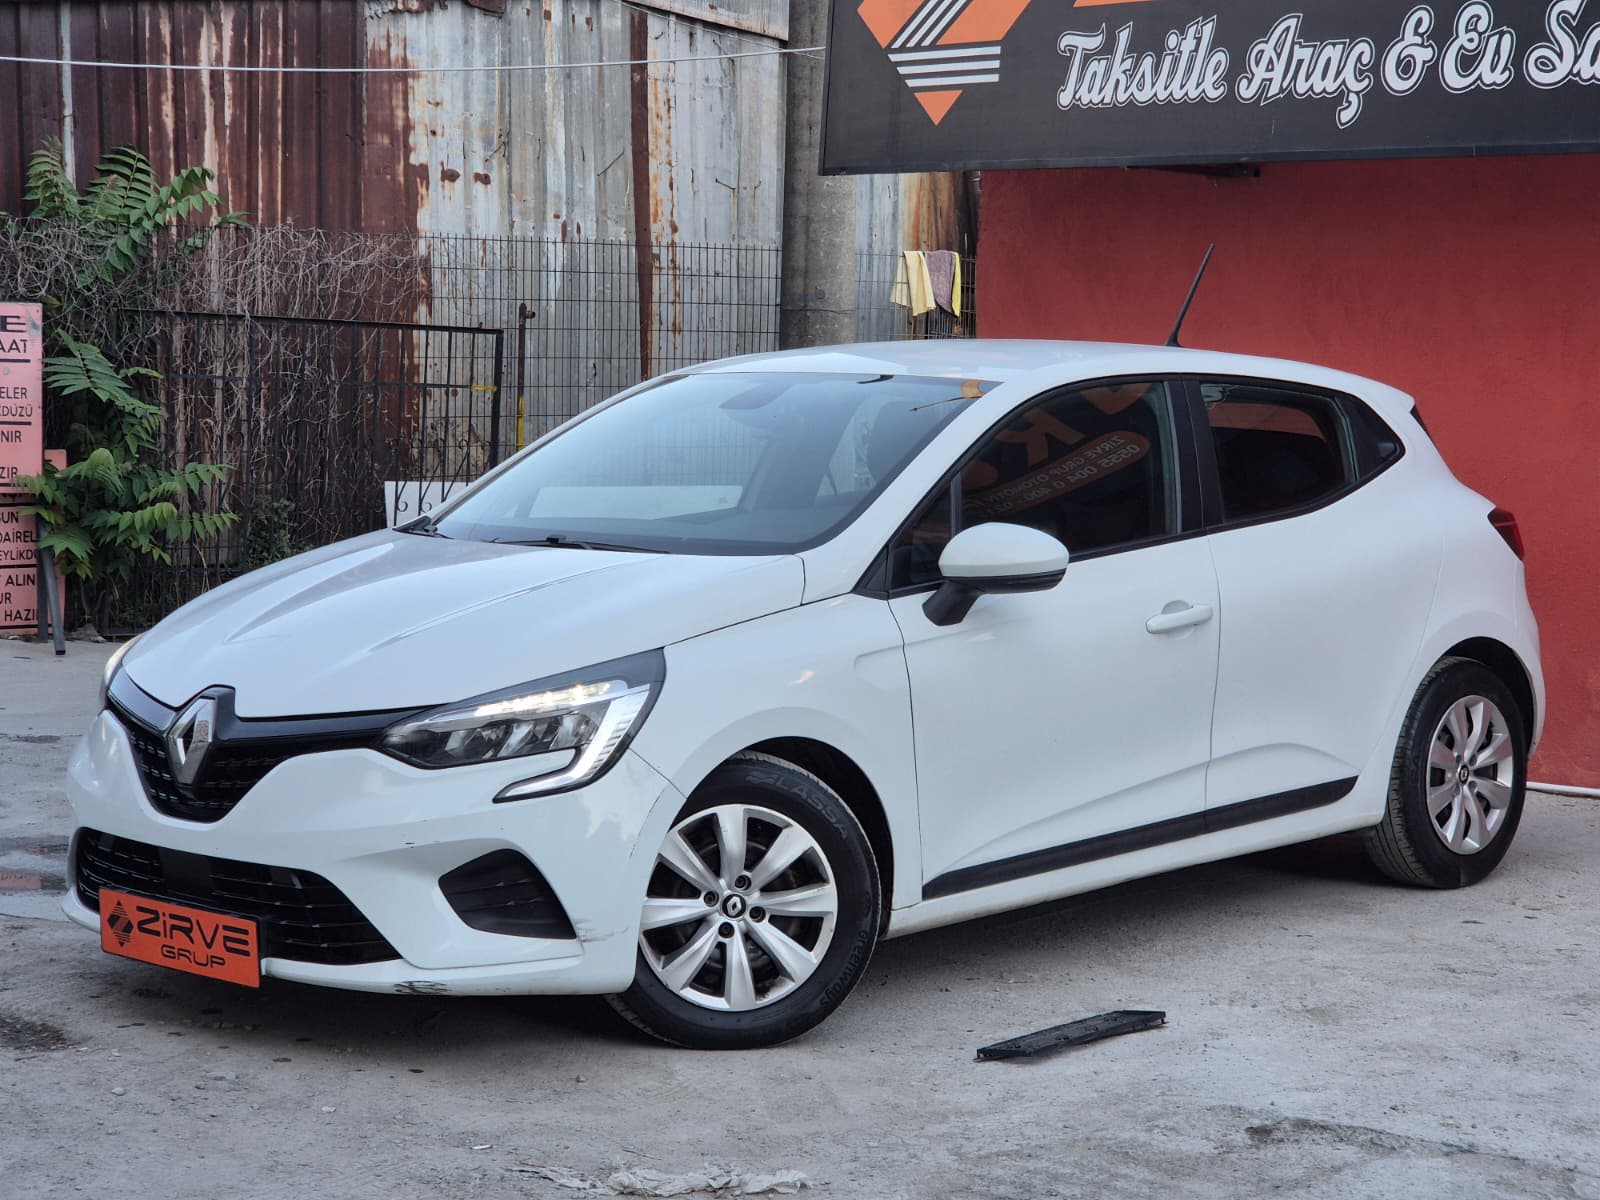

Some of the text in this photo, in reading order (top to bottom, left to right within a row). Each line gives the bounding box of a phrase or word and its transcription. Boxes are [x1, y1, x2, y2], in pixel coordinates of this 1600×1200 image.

[1057, 15, 1227, 109] Taksitle
[1236, 13, 1374, 128] Araç
[1381, 5, 1437, 96] &
[1, 430, 22, 443] NIR
[5, 608, 40, 622] HAZI
[160, 944, 226, 968] GRUP
